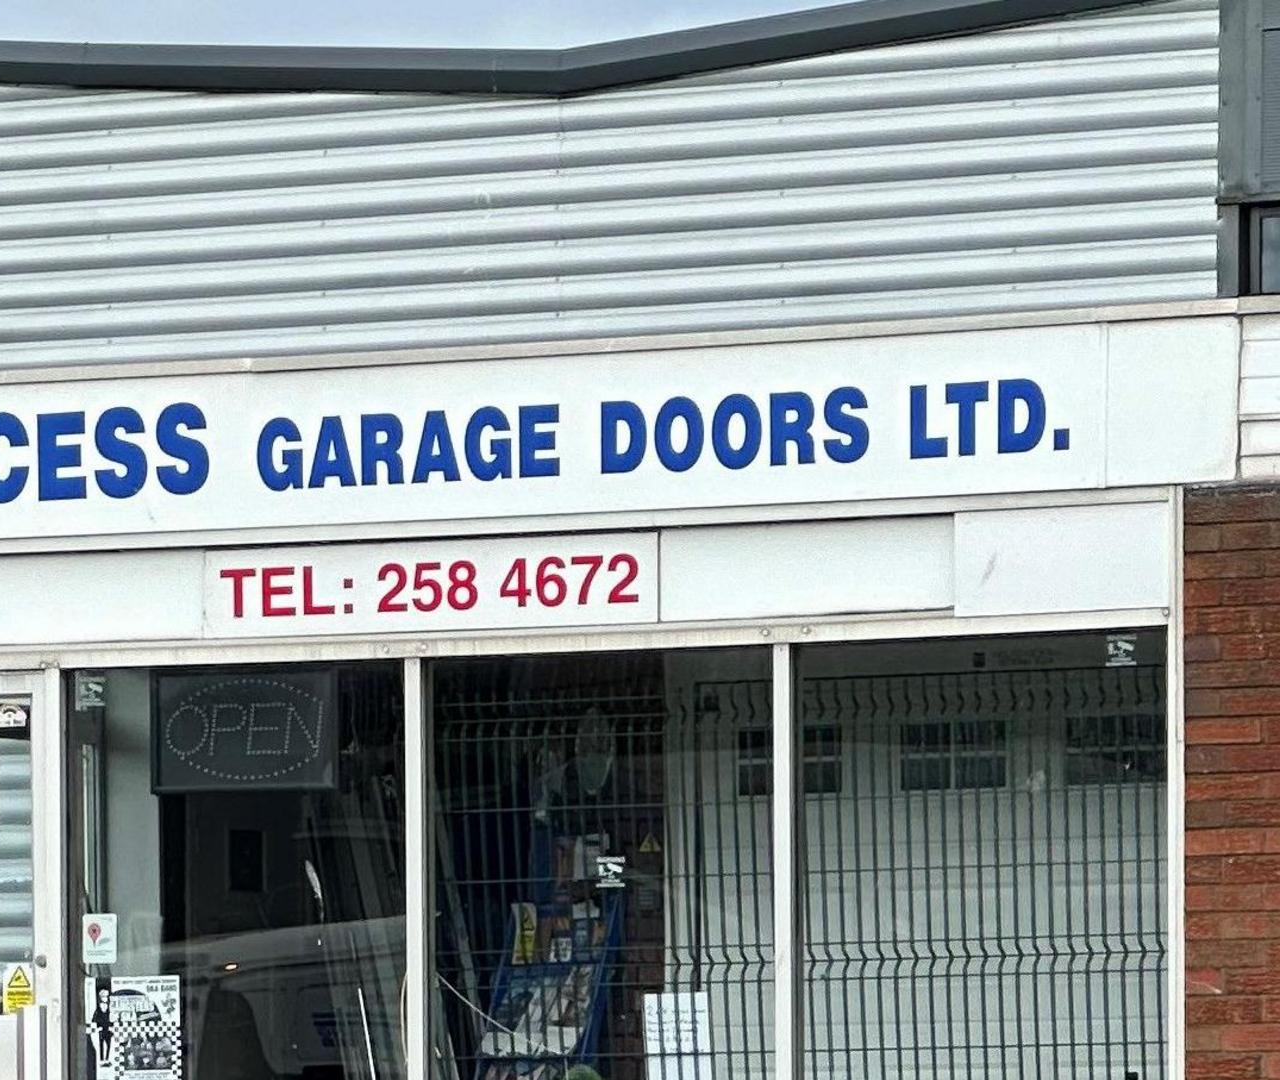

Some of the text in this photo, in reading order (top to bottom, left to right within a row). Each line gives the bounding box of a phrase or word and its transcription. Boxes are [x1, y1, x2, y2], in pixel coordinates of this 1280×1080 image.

[257, 403, 560, 491] GARAGE
[601, 386, 869, 473] DOORS
[910, 378, 1069, 459] LTD.
[220, 553, 639, 618] TEL: 258 4672
[167, 702, 323, 756] OPEN
